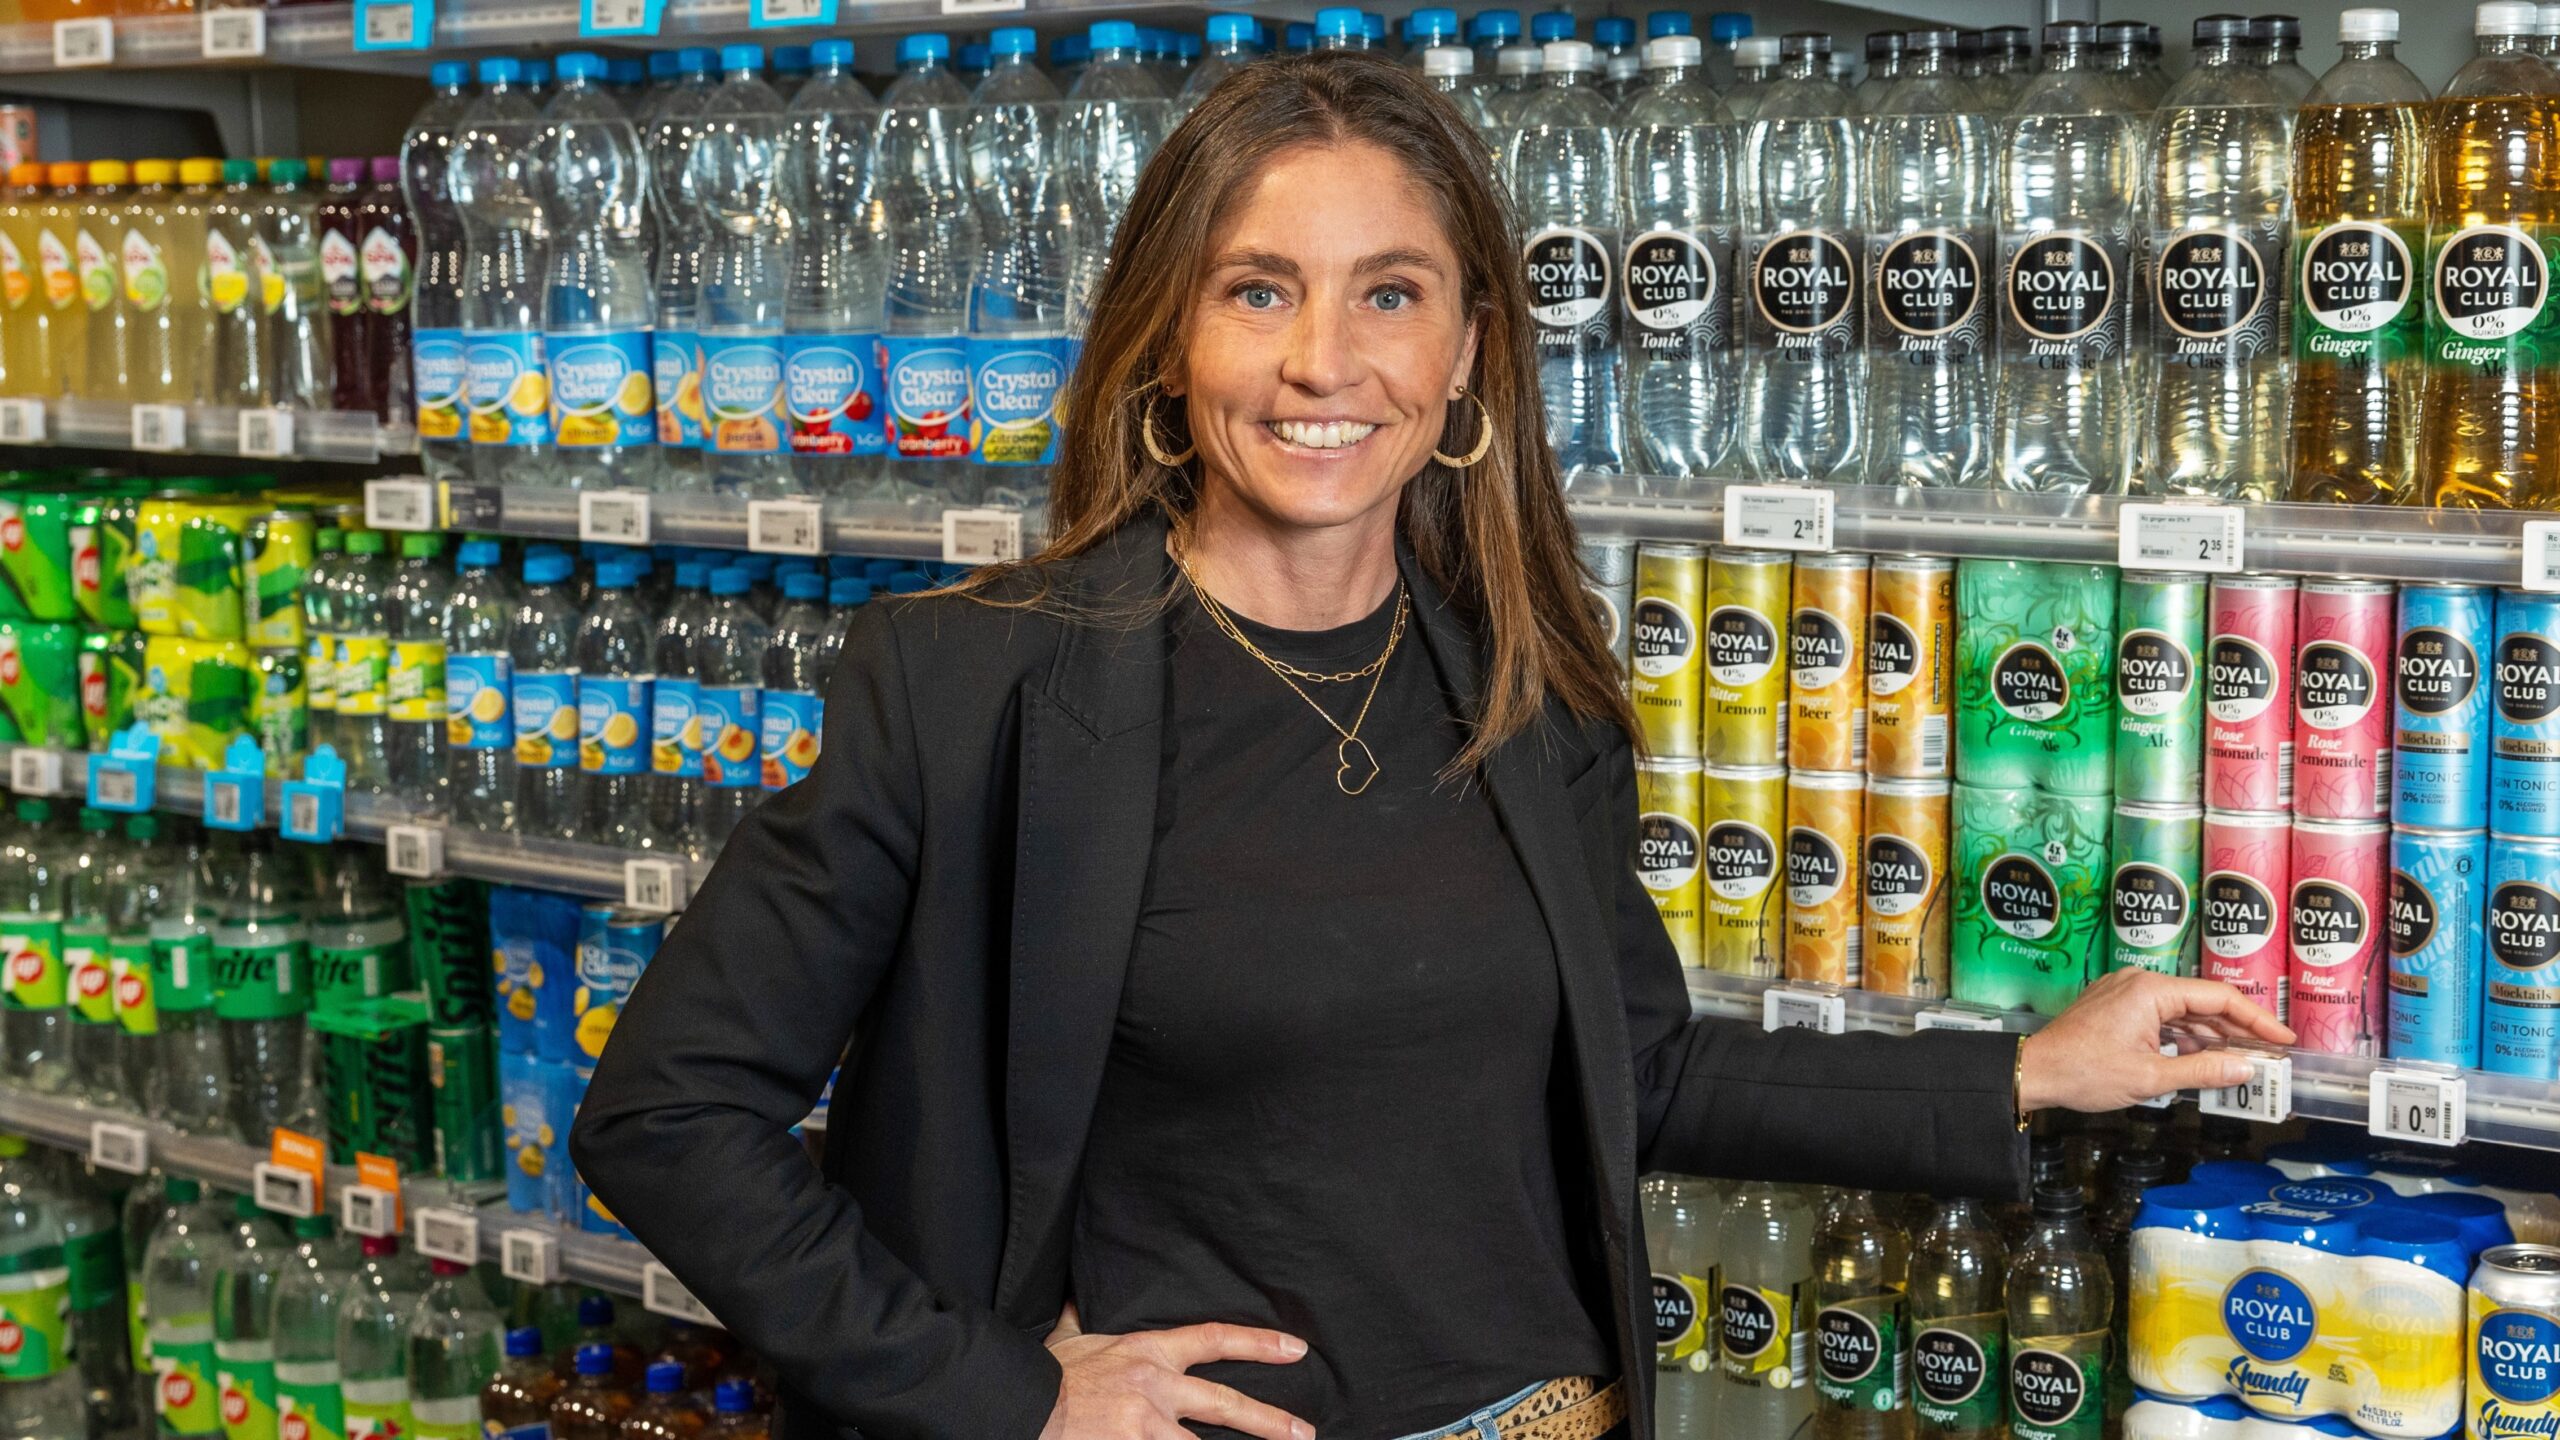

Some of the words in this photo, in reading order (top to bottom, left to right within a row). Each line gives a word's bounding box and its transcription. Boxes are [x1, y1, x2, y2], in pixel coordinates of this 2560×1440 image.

[1528, 263, 1602, 282] ROYAL
[1632, 265, 1706, 284] ROYAL
[1764, 267, 1848, 287] ROYAL
[1887, 268, 1973, 289] ROYAL
[2165, 267, 2256, 289] ROYAL
[2313, 261, 2401, 282] ROYAL
[2446, 266, 2537, 287] ROYAL
[2018, 270, 2107, 292] ROYAL
[1540, 285, 1586, 298] CLUB
[1643, 287, 1687, 300] CLUB
[1778, 291, 1828, 305] CLUB
[1902, 292, 1953, 307] CLUB
[2328, 286, 2380, 299] CLUB
[2460, 291, 2514, 305] CLUB
[2033, 295, 2086, 310] CLUB
[2179, 293, 2233, 308] CLUB
[1551, 304, 1577, 317] 0%
[1653, 307, 1679, 320] 0%
[2340, 308, 2371, 322] 0%
[2472, 314, 2504, 329] 0%
[1537, 329, 1581, 345] Tonic
[1640, 332, 1684, 348] Tonic
[1775, 331, 1822, 348] Tonic
[1898, 335, 1948, 351] Tonic
[2028, 338, 2078, 355] Tonic
[2176, 336, 2227, 355] Tonic
[2309, 334, 2373, 357] Ginger
[2441, 341, 2506, 365] Ginger
[2345, 353, 2375, 369] Ale
[2477, 359, 2509, 377] Ale
[556, 360, 622, 380] Crystal
[711, 363, 780, 383] Crystal
[788, 364, 854, 386] Crystal
[899, 367, 967, 387] Crystal
[983, 369, 1056, 390] Crystal
[558, 381, 607, 399] Clear
[713, 383, 766, 401] Clear
[791, 385, 839, 404] Clear
[902, 386, 956, 406] Clear
[986, 390, 1042, 411] Clear
[898, 436, 964, 453] cranberry
[1638, 641, 1670, 655] CLUB
[1709, 631, 1769, 651] ROYAL
[1643, 658, 1663, 670] 0%
[1717, 651, 1753, 663] CLUB
[1794, 653, 1826, 666] CLUB
[1723, 667, 1745, 679] 0%
[2121, 657, 2185, 678] ROYAL
[2208, 663, 2268, 684] ROYAL
[2399, 656, 2472, 678] ROYAL
[1798, 670, 1819, 682] 0%
[2001, 670, 2062, 693] ROYAL
[2128, 677, 2167, 691] CLUB
[2300, 670, 2366, 691] ROYAL
[2213, 684, 2249, 697] CLUB
[2407, 678, 2453, 693] CLUB
[2503, 685, 2547, 700] CLUB
[1637, 694, 1683, 709] Lemon
[1709, 686, 1743, 703] Bitter
[2014, 688, 2048, 701] CLUB
[2134, 696, 2158, 709] 0%
[2307, 690, 2348, 704] CLUB
[1717, 702, 1767, 716] Lemon
[1799, 705, 1832, 721] Beer
[2023, 704, 2043, 716] 0%
[2218, 702, 2241, 714] 0%
[2313, 709, 2339, 721] 0%
[1871, 711, 1900, 727] Beer
[2009, 725, 2057, 740] Ginger
[2120, 716, 2165, 739] Ginger
[2213, 726, 2245, 743] Rose
[2040, 739, 2060, 753] Ale
[2145, 733, 2173, 749] Ale
[2307, 734, 2343, 750] Rose
[2401, 731, 2458, 746] Mocktails
[2499, 739, 2554, 754] Mocktails
[2398, 769, 2416, 781] GIN
[2418, 771, 2462, 784] TONIC
[2515, 778, 2557, 792] TONIC
[2402, 790, 2419, 803] 0%
[2498, 799, 2514, 811] 0%
[1643, 856, 1678, 869] CLUB
[1709, 845, 1768, 864] ROYAL
[1649, 873, 1672, 884] 0%
[1717, 864, 1753, 877] CLUB
[1790, 871, 1819, 885] CLUB
[1867, 860, 1922, 881] ROYAL
[1722, 881, 1746, 893] 0%
[1871, 881, 1906, 893] CLUB
[1990, 881, 2053, 908] ROYAL
[1709, 899, 1744, 915] Bitter
[1875, 897, 1899, 910] 0%
[2115, 889, 2180, 911] ROYAL
[2003, 902, 2040, 918] CLUB
[2123, 910, 2163, 924] CLUB
[2205, 898, 2267, 921] ROYAL
[2294, 906, 2359, 929] ROYAL
[1718, 914, 1770, 928] Lemon
[2013, 921, 2035, 934] 0%
[2211, 919, 2249, 934] CLUB
[1793, 922, 1826, 938] Beer
[2129, 928, 2154, 941] 0%
[2300, 928, 2340, 942] CLUB
[1876, 930, 1912, 947] Beer
[2217, 937, 2240, 950] 0%
[2500, 932, 2546, 948] CLUB
[2000, 941, 2050, 961] Ginger
[2114, 947, 2162, 969] Ginger
[2306, 946, 2331, 959] 0%
[2032, 959, 2054, 973] Ale
[2212, 961, 2244, 978] Rose
[2301, 971, 2336, 988] Rose
[2494, 984, 2552, 1001] Mocktails
[2490, 1020, 2508, 1032] GIN
[2511, 1024, 2556, 1037] TONIC
[2495, 1043, 2512, 1056] 0%
[2231, 1298, 2311, 1327] ROYAL
[1725, 1326, 1755, 1341] CLUB
[2245, 1321, 2291, 1341] CLUB
[1824, 1349, 1859, 1364] CLUB
[1917, 1349, 1979, 1372] ROYAL
[1925, 1371, 1963, 1385] CLUB
[2495, 1363, 2547, 1381] CLUB
[2015, 1370, 2078, 1394] ROYAL
[2225, 1355, 2310, 1407] Shandy
[2023, 1391, 2062, 1407] CLUB
[1917, 1402, 1958, 1423] Ginger
[2478, 1399, 2560, 1437] Shandy
